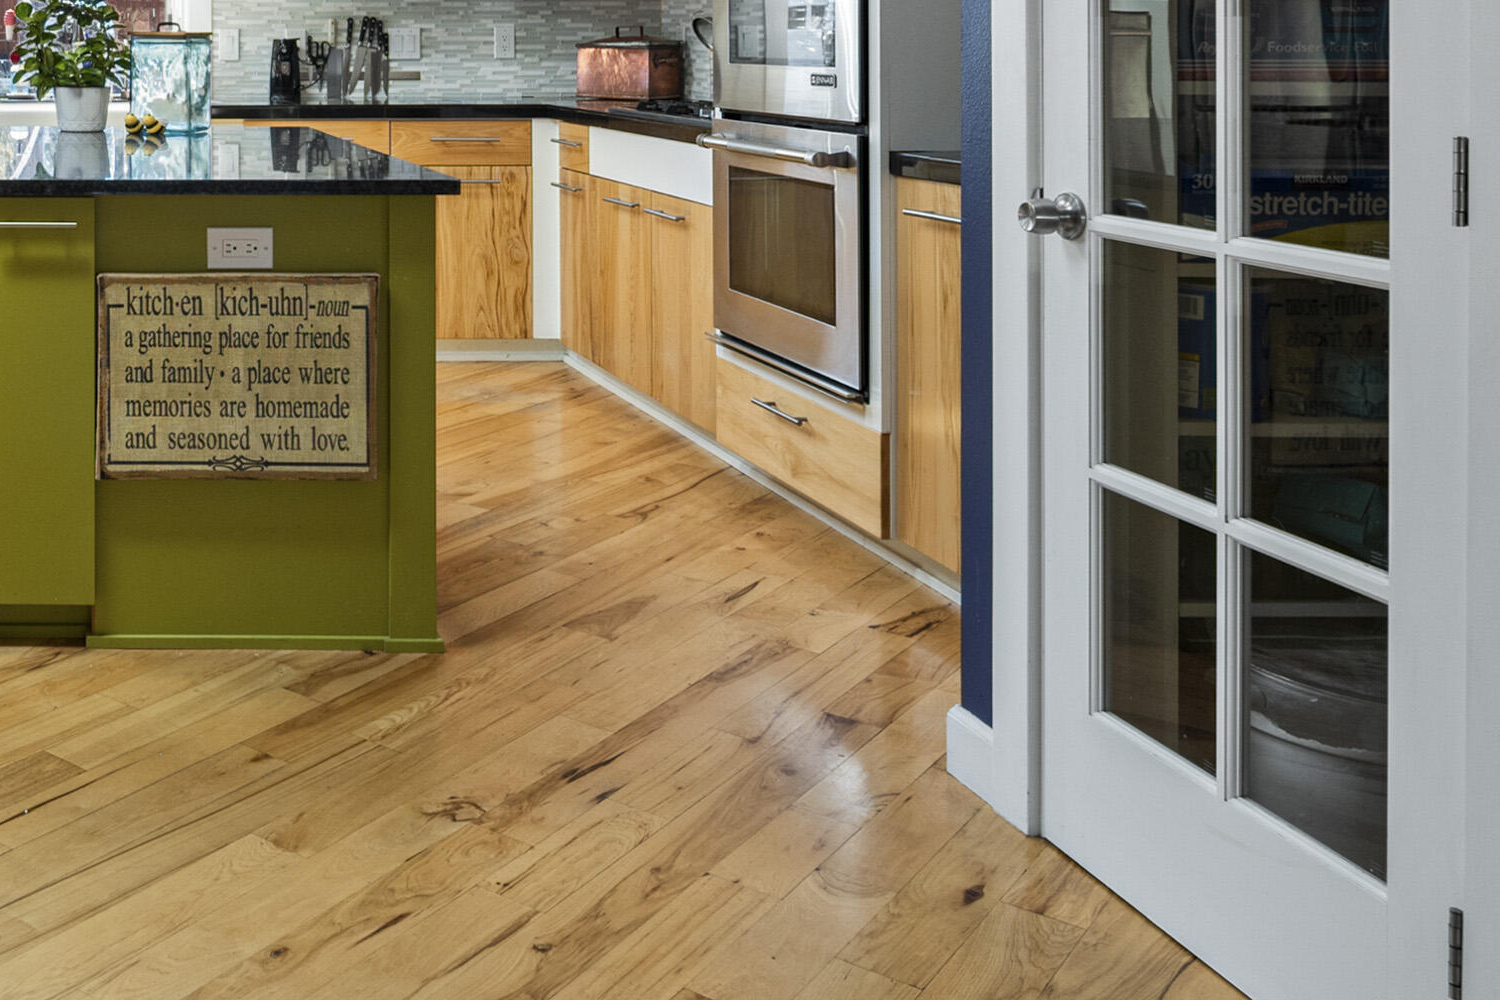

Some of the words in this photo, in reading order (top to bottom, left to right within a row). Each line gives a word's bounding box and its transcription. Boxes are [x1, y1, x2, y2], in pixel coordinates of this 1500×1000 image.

[1294, 173, 1349, 185] KIRKLAND
[1250, 190, 1388, 217] stretch-tite
[125, 332, 133, 348] a
[138, 324, 212, 354] gathering
[218, 324, 260, 355] place
[266, 324, 289, 349] for
[295, 324, 350, 349] friends
[125, 359, 154, 384] and
[232, 366, 241, 384] a
[247, 360, 291, 391] place
[298, 360, 350, 384] where
[125, 393, 212, 418] memories
[219, 401, 247, 418] are
[254, 394, 350, 419] homemade
[125, 425, 157, 450] and
[168, 426, 250, 450] seasoned
[260, 426, 301, 450] with
[311, 426, 350, 451] love.
